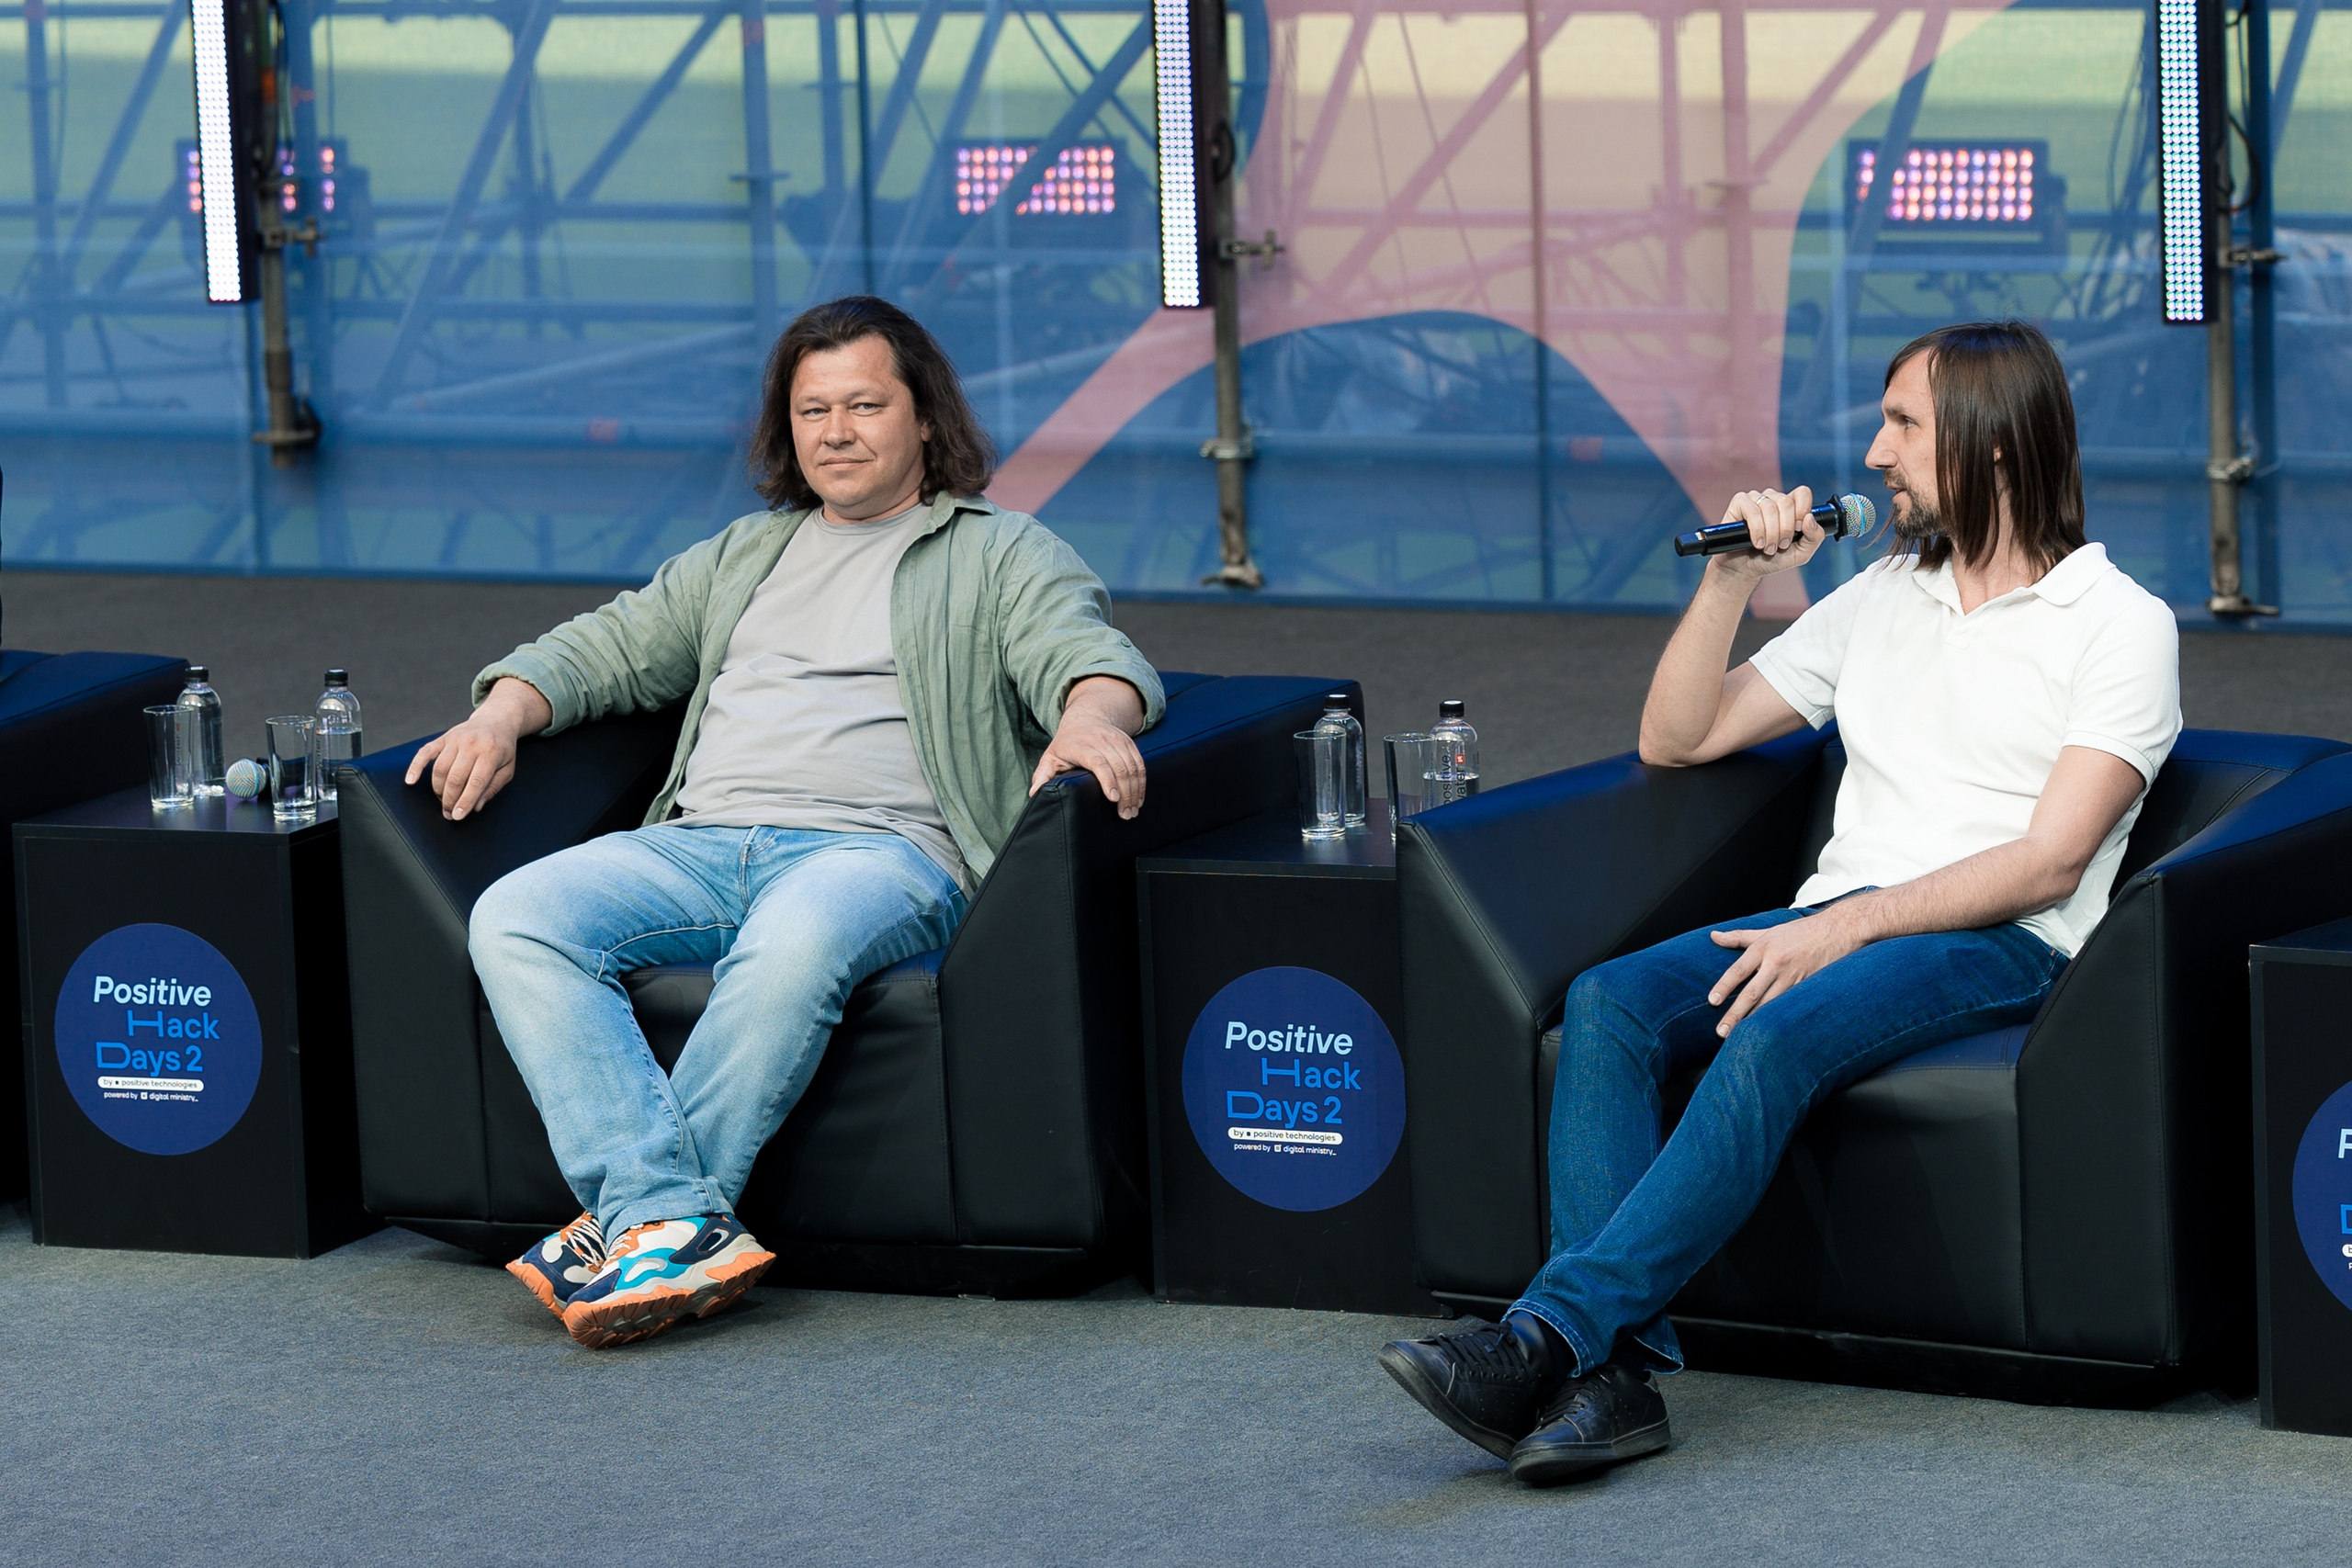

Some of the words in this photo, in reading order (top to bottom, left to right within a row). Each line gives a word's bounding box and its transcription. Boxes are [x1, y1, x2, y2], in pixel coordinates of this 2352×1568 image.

[94, 976, 211, 1007] Positive
[127, 1010, 220, 1039] Hack
[1225, 1021, 1353, 1055] Positive
[96, 1042, 181, 1077] Days
[185, 1045, 203, 1072] 2
[1261, 1057, 1362, 1089] Hack
[103, 1078, 113, 1087] by
[121, 1079, 150, 1088] positive
[151, 1079, 198, 1090] technologies
[104, 1091, 130, 1100] powered
[130, 1092, 139, 1100] by
[1227, 1090, 1318, 1129] Days
[1323, 1096, 1342, 1124] 2
[1233, 1129, 1244, 1138] by
[1253, 1130, 1284, 1139] positive
[1285, 1131, 1336, 1143] technologies
[1234, 1143, 1261, 1151] powered
[1262, 1144, 1272, 1153] by
[1283, 1145, 1305, 1155] digital
